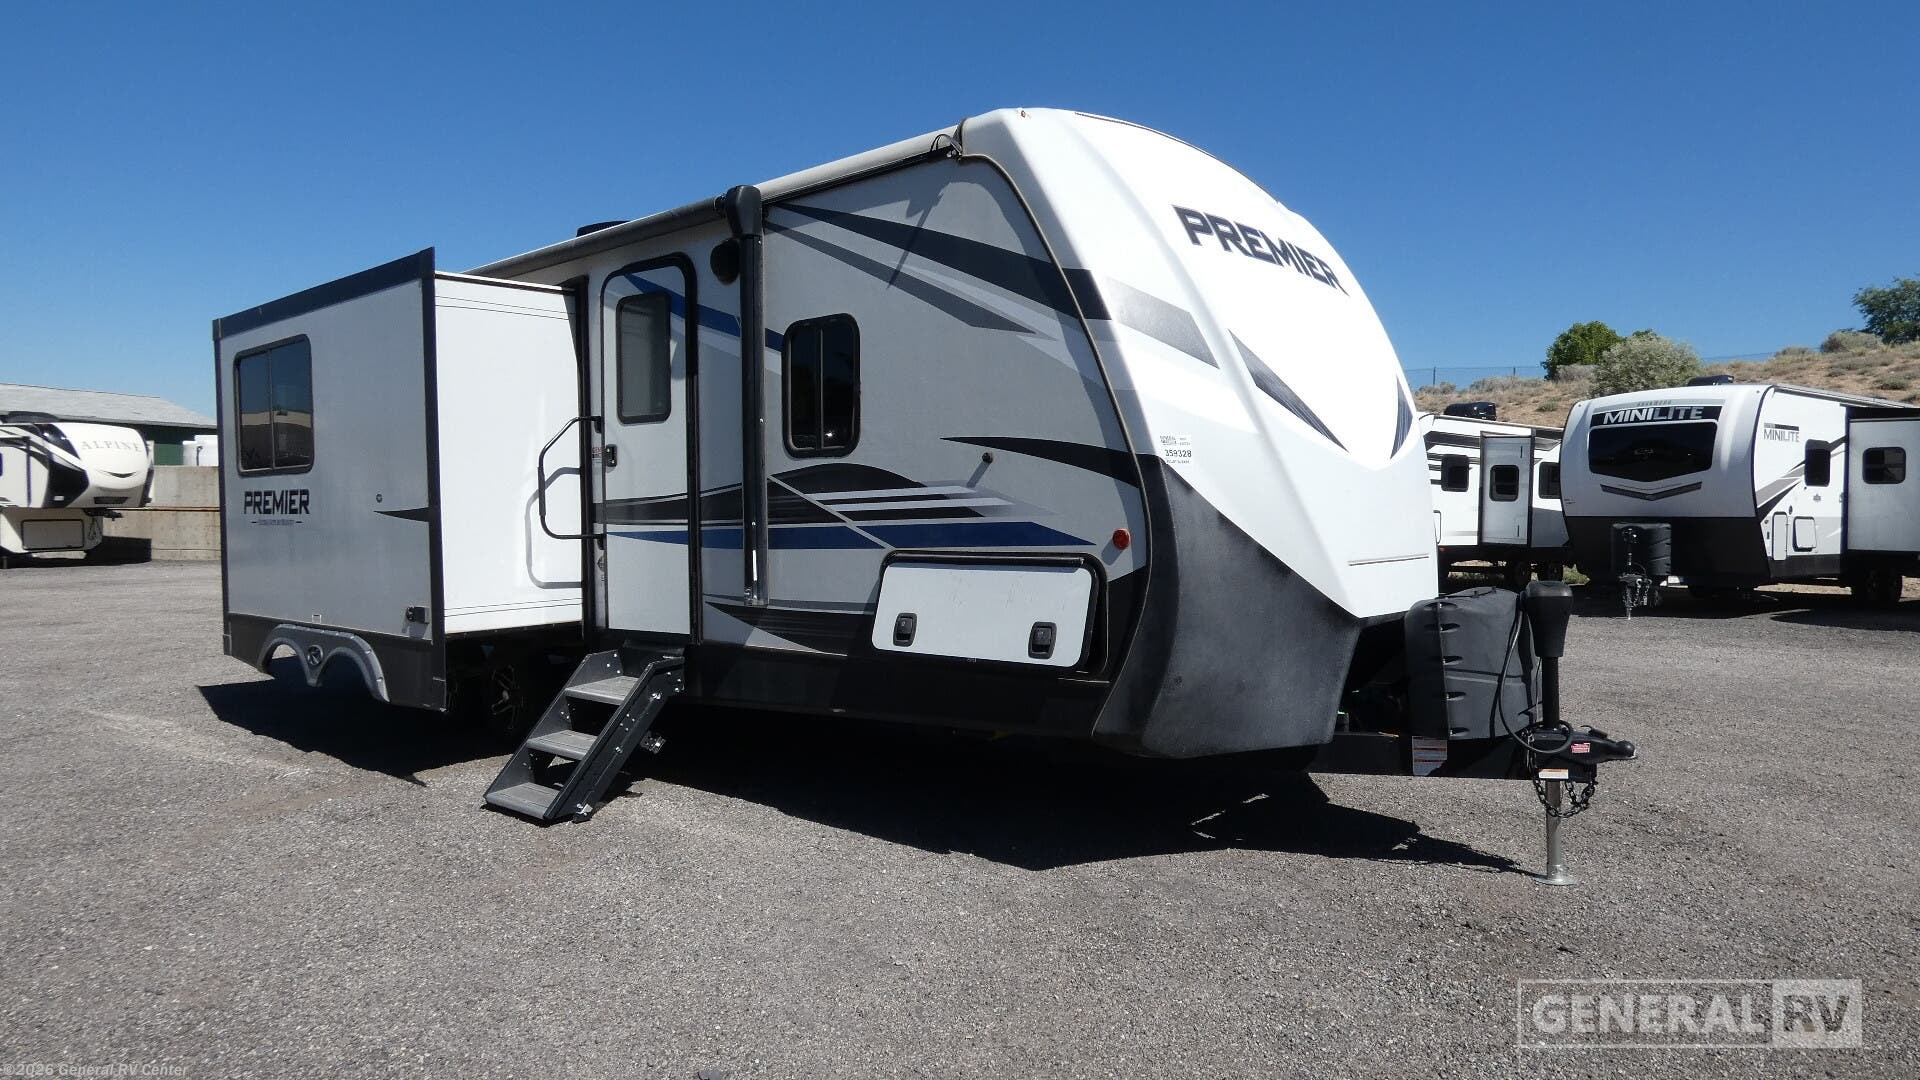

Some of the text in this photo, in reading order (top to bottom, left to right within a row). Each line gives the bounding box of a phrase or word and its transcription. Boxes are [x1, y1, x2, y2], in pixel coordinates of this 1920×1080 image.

[1172, 204, 1349, 296] PREMIER
[1603, 406, 1704, 425] MINILITE
[1763, 429, 1800, 442] MINILITE
[81, 440, 142, 452] ALPINE
[1165, 449, 1192, 457] 359328
[243, 488, 310, 515] PREMIER
